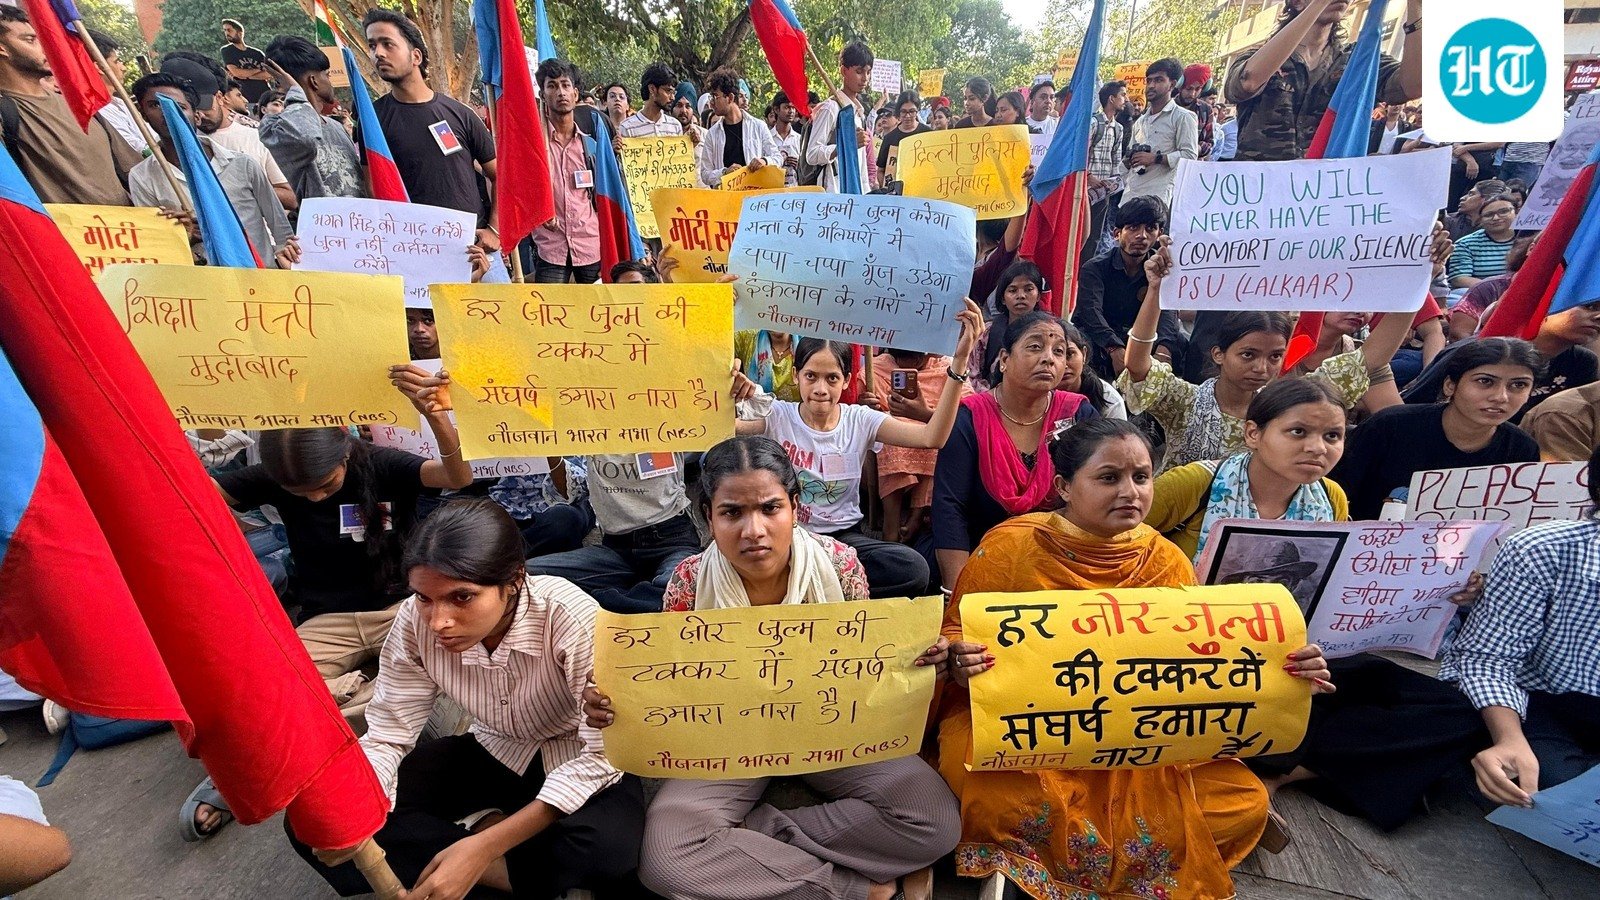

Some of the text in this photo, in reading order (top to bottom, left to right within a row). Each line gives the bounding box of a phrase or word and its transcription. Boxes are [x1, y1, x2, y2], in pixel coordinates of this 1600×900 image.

[912, 133, 1021, 168] दिल्ली पुलिस
[1199, 167, 1384, 208] YOU WILL
[312, 213, 344, 228] भगत
[379, 213, 399, 235] को
[402, 221, 428, 234] याद
[670, 206, 712, 251] मोदी
[909, 202, 957, 230] करेगा
[1190, 202, 1393, 233] NEVER HAVE THE
[83, 214, 142, 251] मोदी
[355, 235, 388, 254] नहीं
[787, 216, 807, 239] के
[887, 227, 914, 252] से
[1179, 234, 1432, 266] COMFORT OF OUR SILENCE
[834, 285, 856, 308] के
[863, 287, 910, 315] नारों
[1179, 272, 1353, 302] PSU (LALKAAR)
[125, 278, 334, 338] शिक्षा मंत्री
[461, 299, 506, 324] हर
[655, 297, 700, 327] की
[537, 333, 659, 365] टक्कर में
[628, 389, 685, 409] नारा
[310, 414, 346, 427] सभा
[348, 410, 398, 424] (NBS)
[657, 421, 707, 443] (NBS)
[1415, 462, 1572, 511] PLEASE
[607, 626, 660, 648] हर
[836, 609, 889, 644] की
[985, 603, 1058, 647] हर
[615, 659, 741, 682] टक्कर
[1053, 647, 1268, 696] की टक्कर में
[739, 701, 802, 722] नारा
[1000, 696, 1257, 750] संघर्ष हमारा
[853, 735, 910, 759] (NBS)
[1091, 744, 1172, 768] नारा
